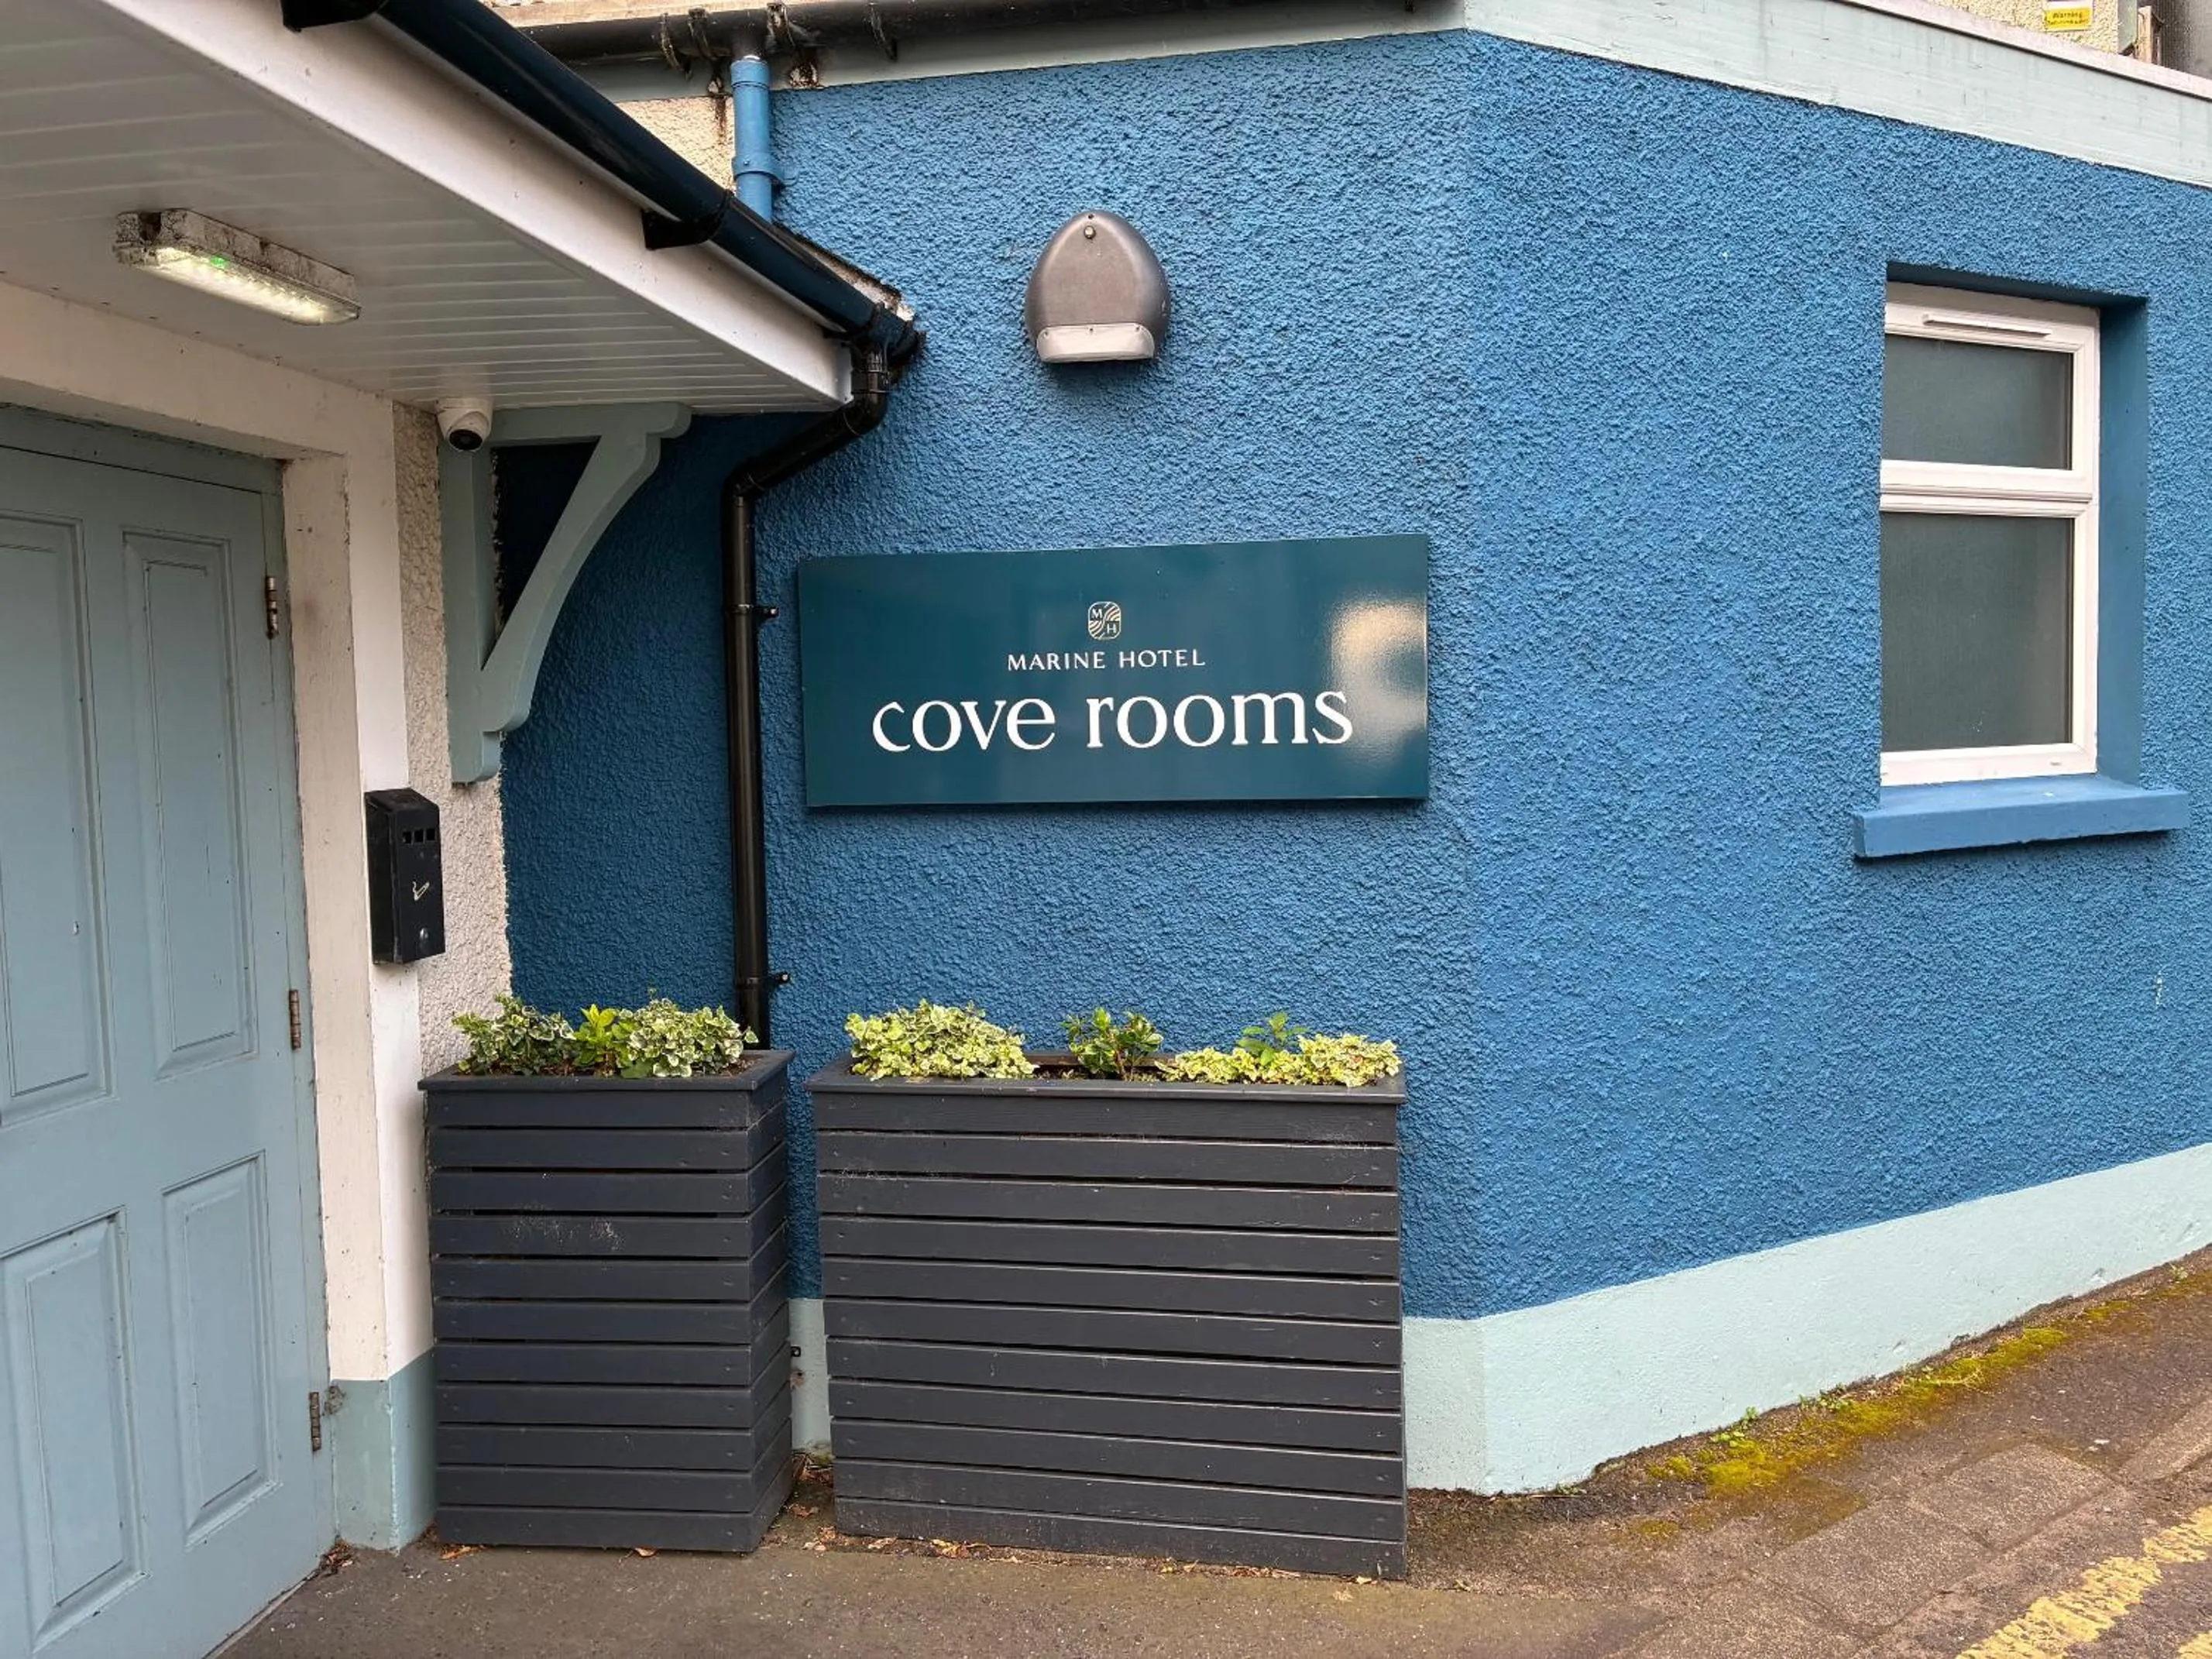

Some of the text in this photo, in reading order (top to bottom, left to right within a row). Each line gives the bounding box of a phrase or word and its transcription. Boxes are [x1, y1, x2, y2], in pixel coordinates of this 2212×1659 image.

[1008, 648, 1206, 671] MARINE HOTEL
[872, 690, 1353, 752] cove rooms
